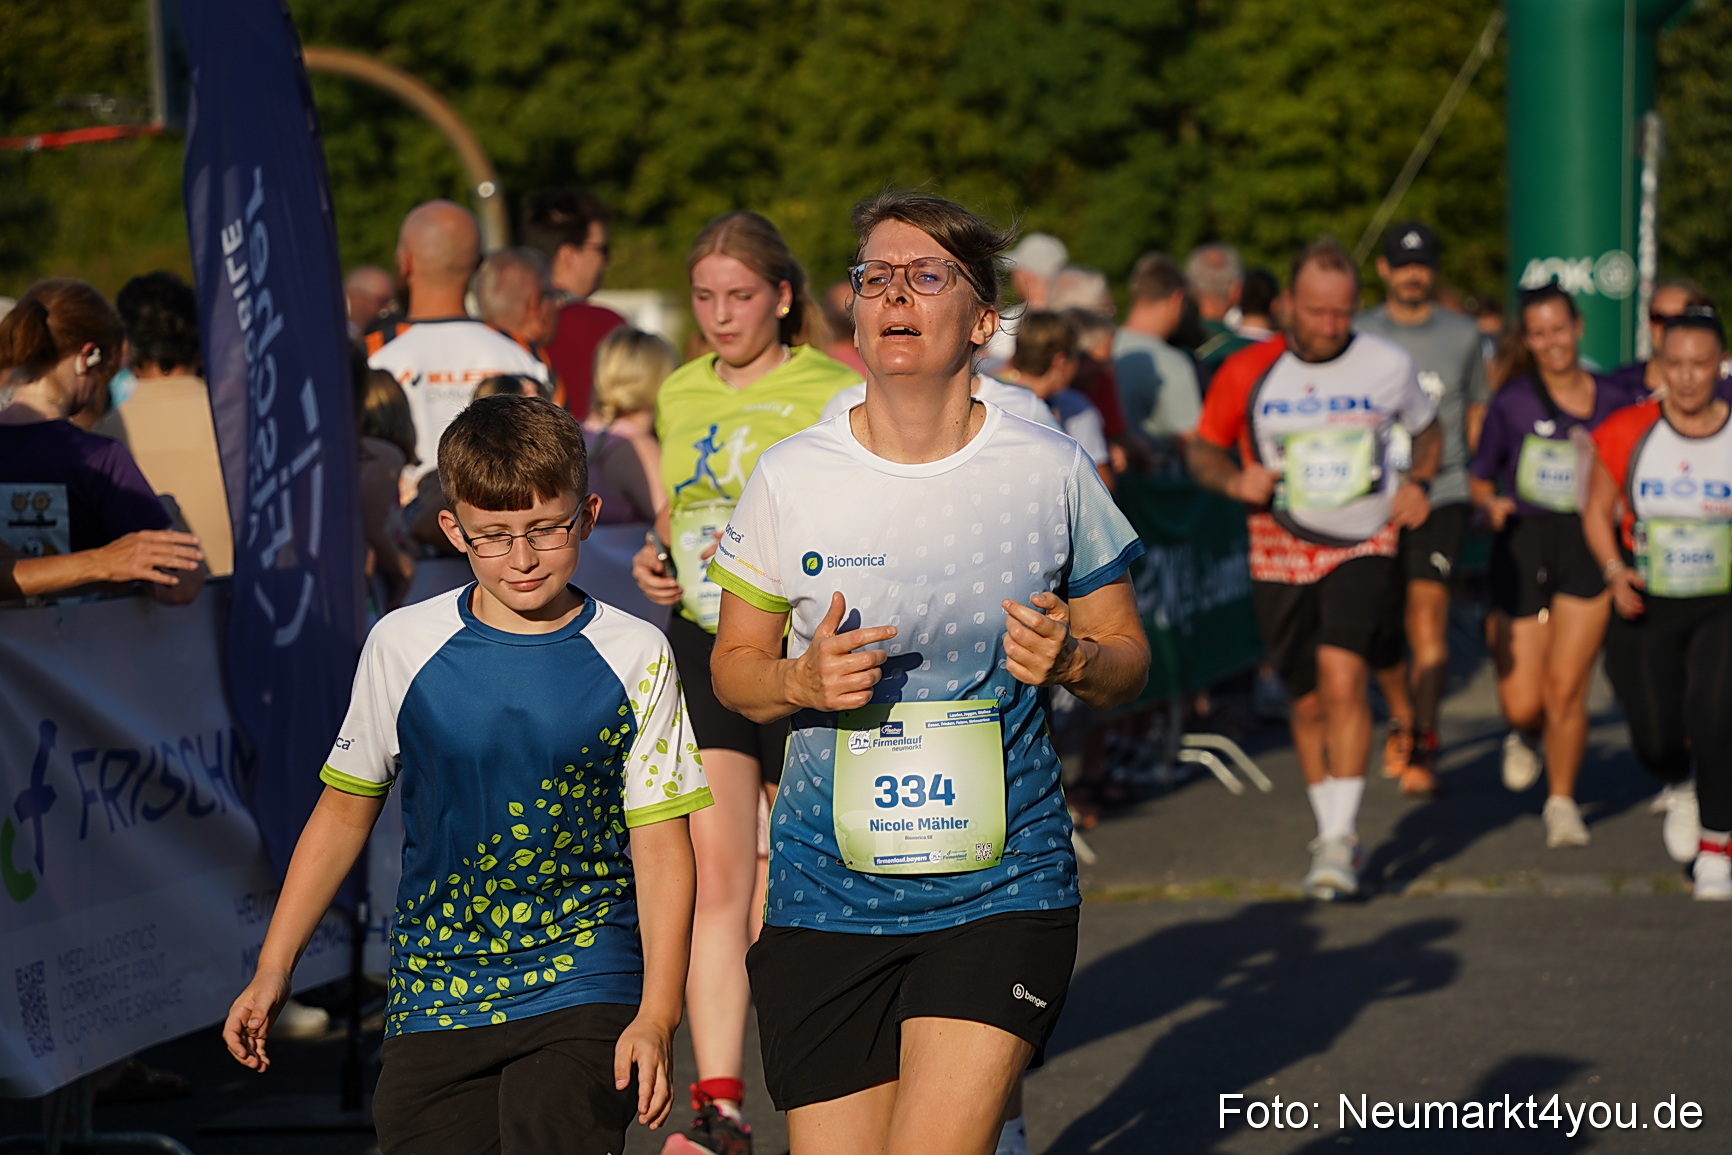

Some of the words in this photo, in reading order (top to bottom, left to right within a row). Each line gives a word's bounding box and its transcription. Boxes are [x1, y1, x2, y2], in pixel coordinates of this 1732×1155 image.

[873, 735, 923, 748] Firmenlauf
[891, 744, 922, 752] neumarkt
[874, 774, 956, 809] 334
[869, 818, 914, 832] Nicole
[917, 816, 969, 831] Mähler
[876, 854, 928, 866] firmenlauf.bayern
[1024, 989, 1047, 1008] benger
